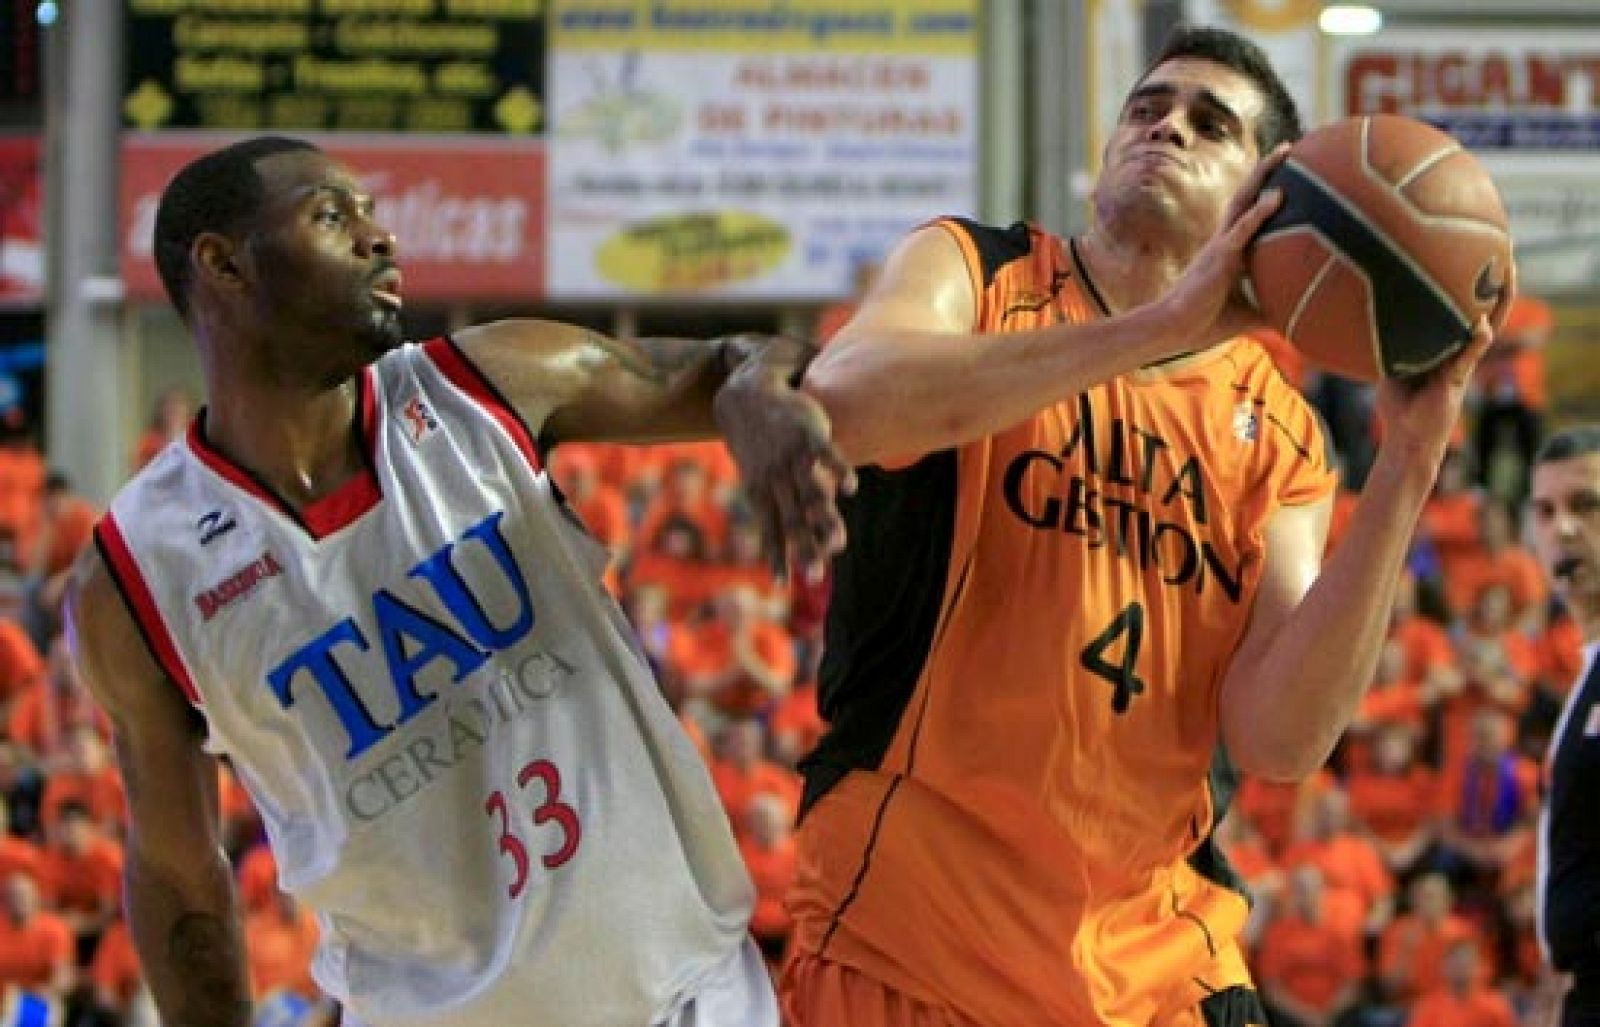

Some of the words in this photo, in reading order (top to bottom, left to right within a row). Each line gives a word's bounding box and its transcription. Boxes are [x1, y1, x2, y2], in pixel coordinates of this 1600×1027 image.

[267, 511, 536, 760] TAU
[1079, 601, 1145, 715] 4
[485, 760, 581, 899] 33
